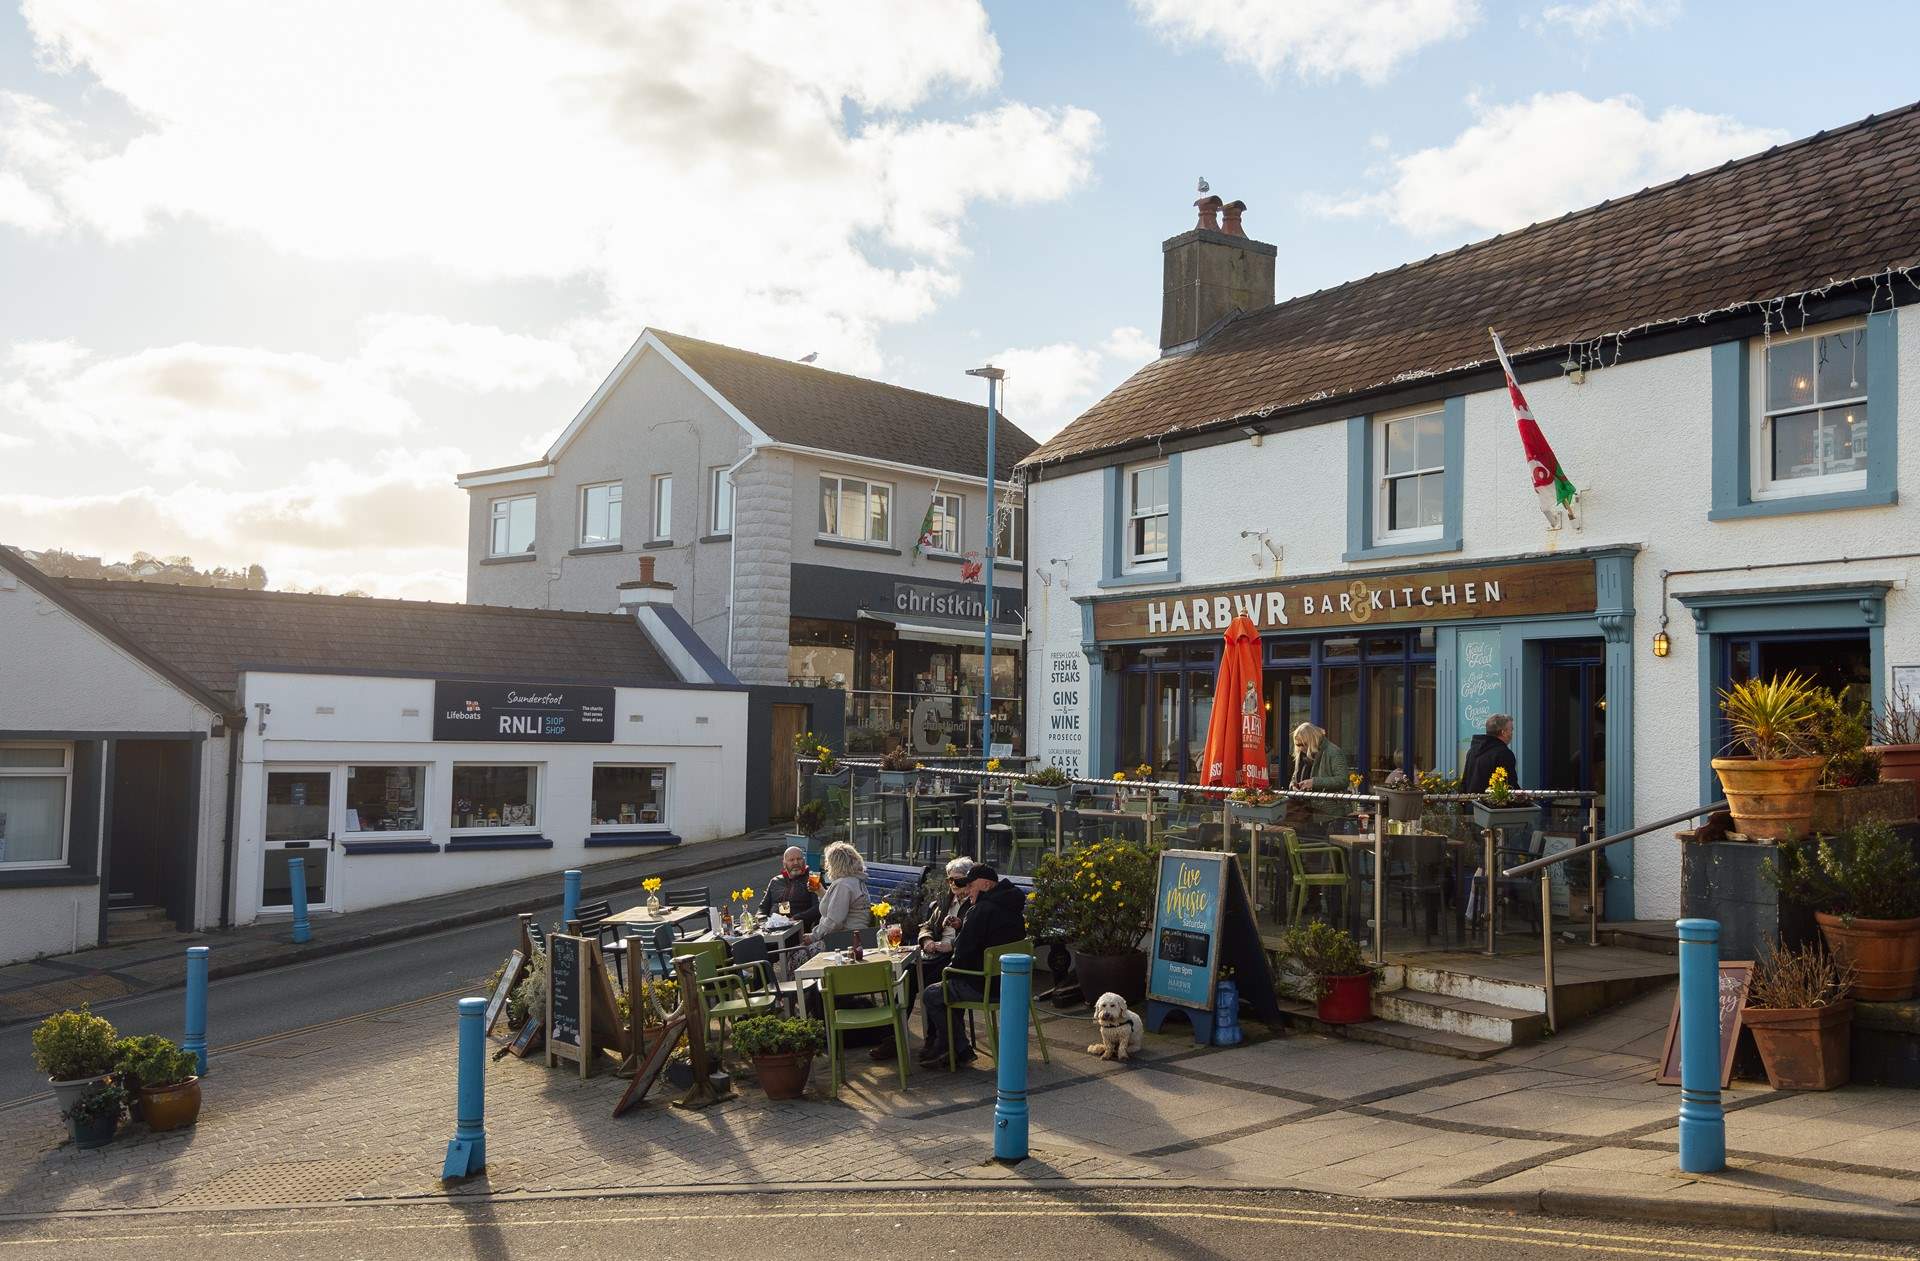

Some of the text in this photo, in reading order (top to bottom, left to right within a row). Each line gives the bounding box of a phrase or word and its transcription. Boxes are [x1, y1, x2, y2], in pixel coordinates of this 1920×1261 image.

[896, 589, 1000, 619] christkinl
[1148, 580, 1501, 634] HARBWR BAR & KITCHEN
[1065, 650, 1080, 658] LOCAL
[1053, 659, 1078, 671] FISH &
[1051, 671, 1080, 683] STEAKS
[507, 691, 563, 705] Saundersfoot
[1053, 691, 1078, 706] GINS
[446, 711, 481, 720] Lifeboats
[545, 717, 564, 725] SIOP
[499, 716, 542, 734] RNLI
[1051, 715, 1080, 730] WINE
[545, 726, 566, 735] SHOP
[1048, 733, 1082, 741] PROSECCO
[1051, 756, 1078, 767] CASK
[1177, 862, 1201, 890] Live
[1167, 888, 1208, 920] Music
[1182, 918, 1207, 931] Saturday
